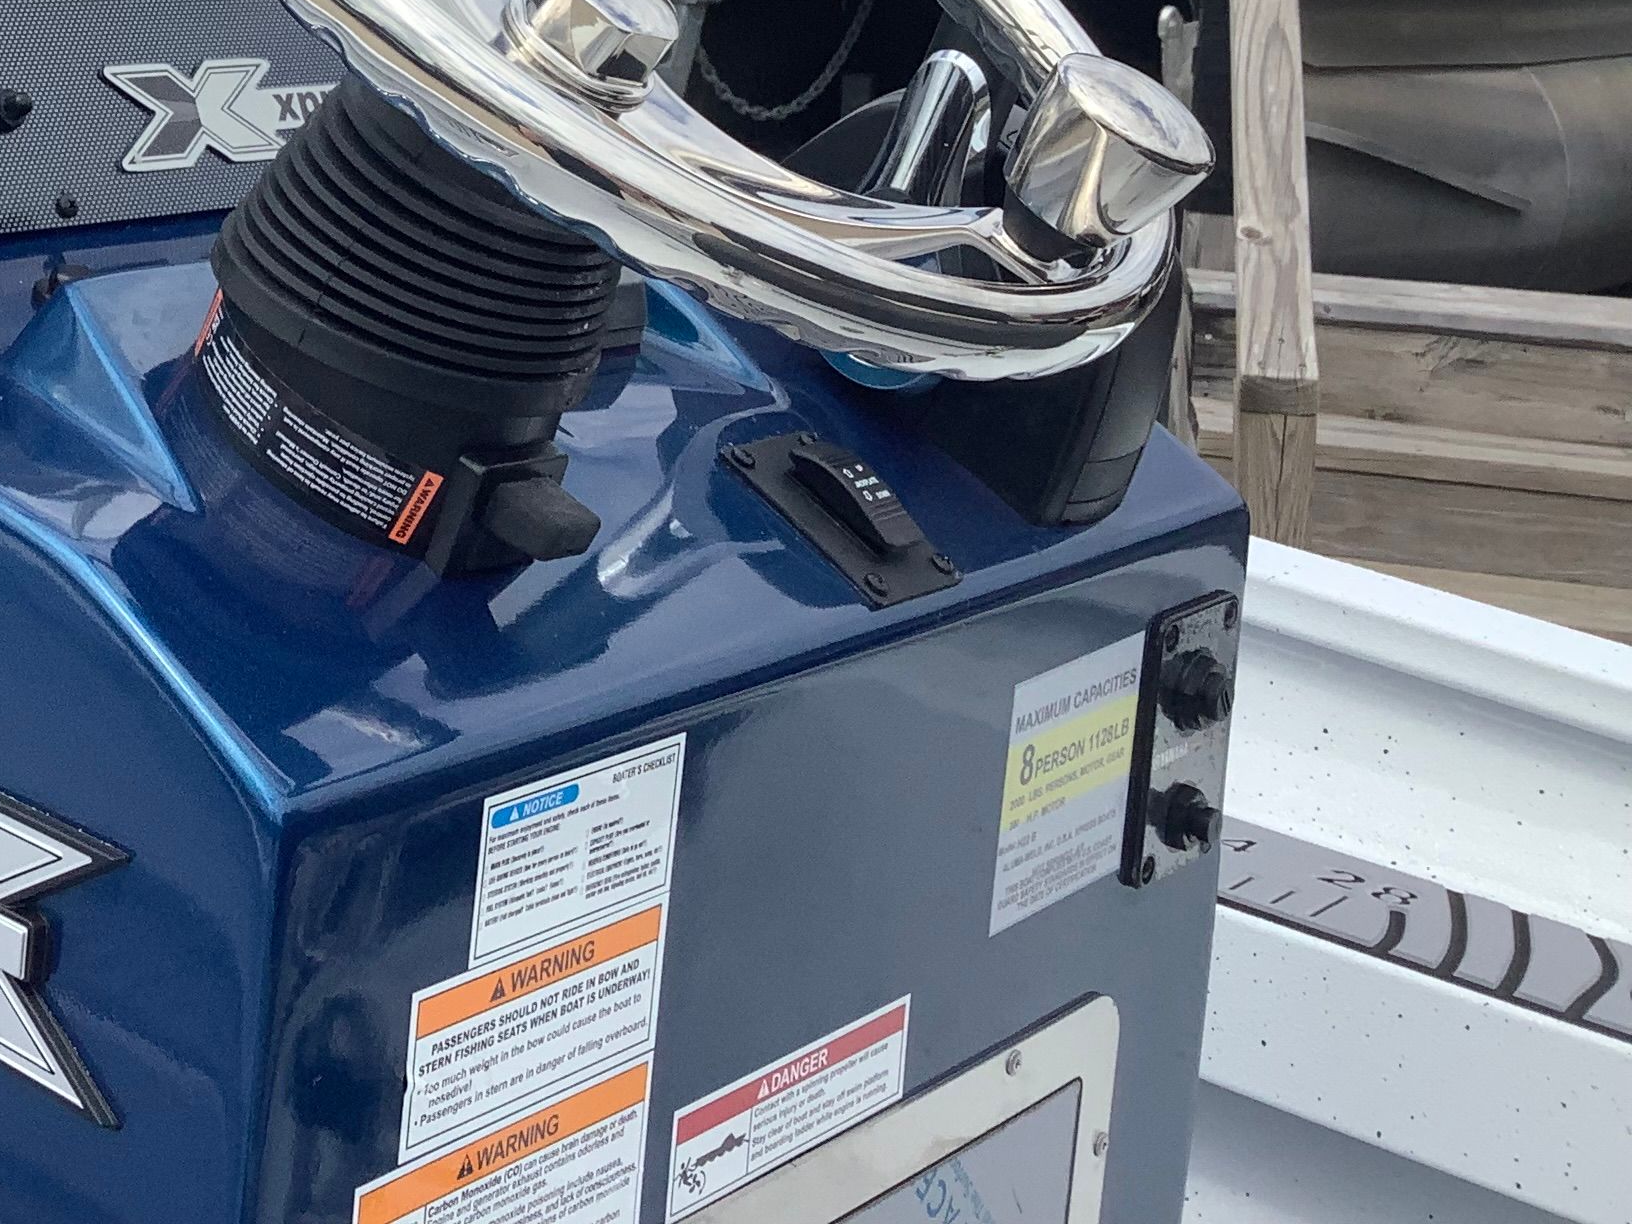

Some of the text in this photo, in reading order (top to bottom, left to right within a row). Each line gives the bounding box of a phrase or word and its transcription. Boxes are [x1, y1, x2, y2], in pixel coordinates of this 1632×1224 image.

[394, 487, 431, 539] WARNING
[1015, 667, 1137, 734] MAXIMUM CAPACITIES
[643, 754, 675, 771] CHECKLIST
[1019, 742, 1035, 786] 8
[1034, 737, 1085, 777] PERSON
[522, 791, 564, 815] NOTICE
[1317, 869, 1419, 905] 28
[510, 939, 595, 992] WARNING
[418, 968, 650, 1076] STERN FISHING SEATS WHEN BOAT IS UNDERWAY!
[430, 959, 639, 1055] PASSENGERS SHOULD NOT RIDE IN BOW AND
[423, 991, 641, 1095] Too much weight in the bow could cause the boat to
[419, 1015, 648, 1128] Passengers in stern are in danger of falling overboard.
[428, 1079, 472, 1107] nosedive!
[770, 1049, 828, 1092] DANGER
[475, 1113, 559, 1170] WARNING
[427, 1195, 458, 1217] Carbon
[461, 1174, 502, 1200] Monoxide
[503, 1163, 522, 1182] (CO)
[523, 1159, 536, 1170] can
[538, 1147, 560, 1164] cause
[561, 1137, 579, 1152] brain
[580, 1123, 608, 1145] damage
[610, 1120, 616, 1130] or
[456, 1127, 624, 1216] and generator exhaust contains odorless and
[527, 1186, 564, 1211] poisoning
[566, 1172, 592, 1190] include
[463, 1205, 491, 1223] carbon
[492, 1185, 530, 1210] monoxide
[545, 1200, 559, 1213] and
[559, 1191, 575, 1205] lack
[575, 1187, 583, 1198] of
[558, 1195, 594, 1218] of carbon
